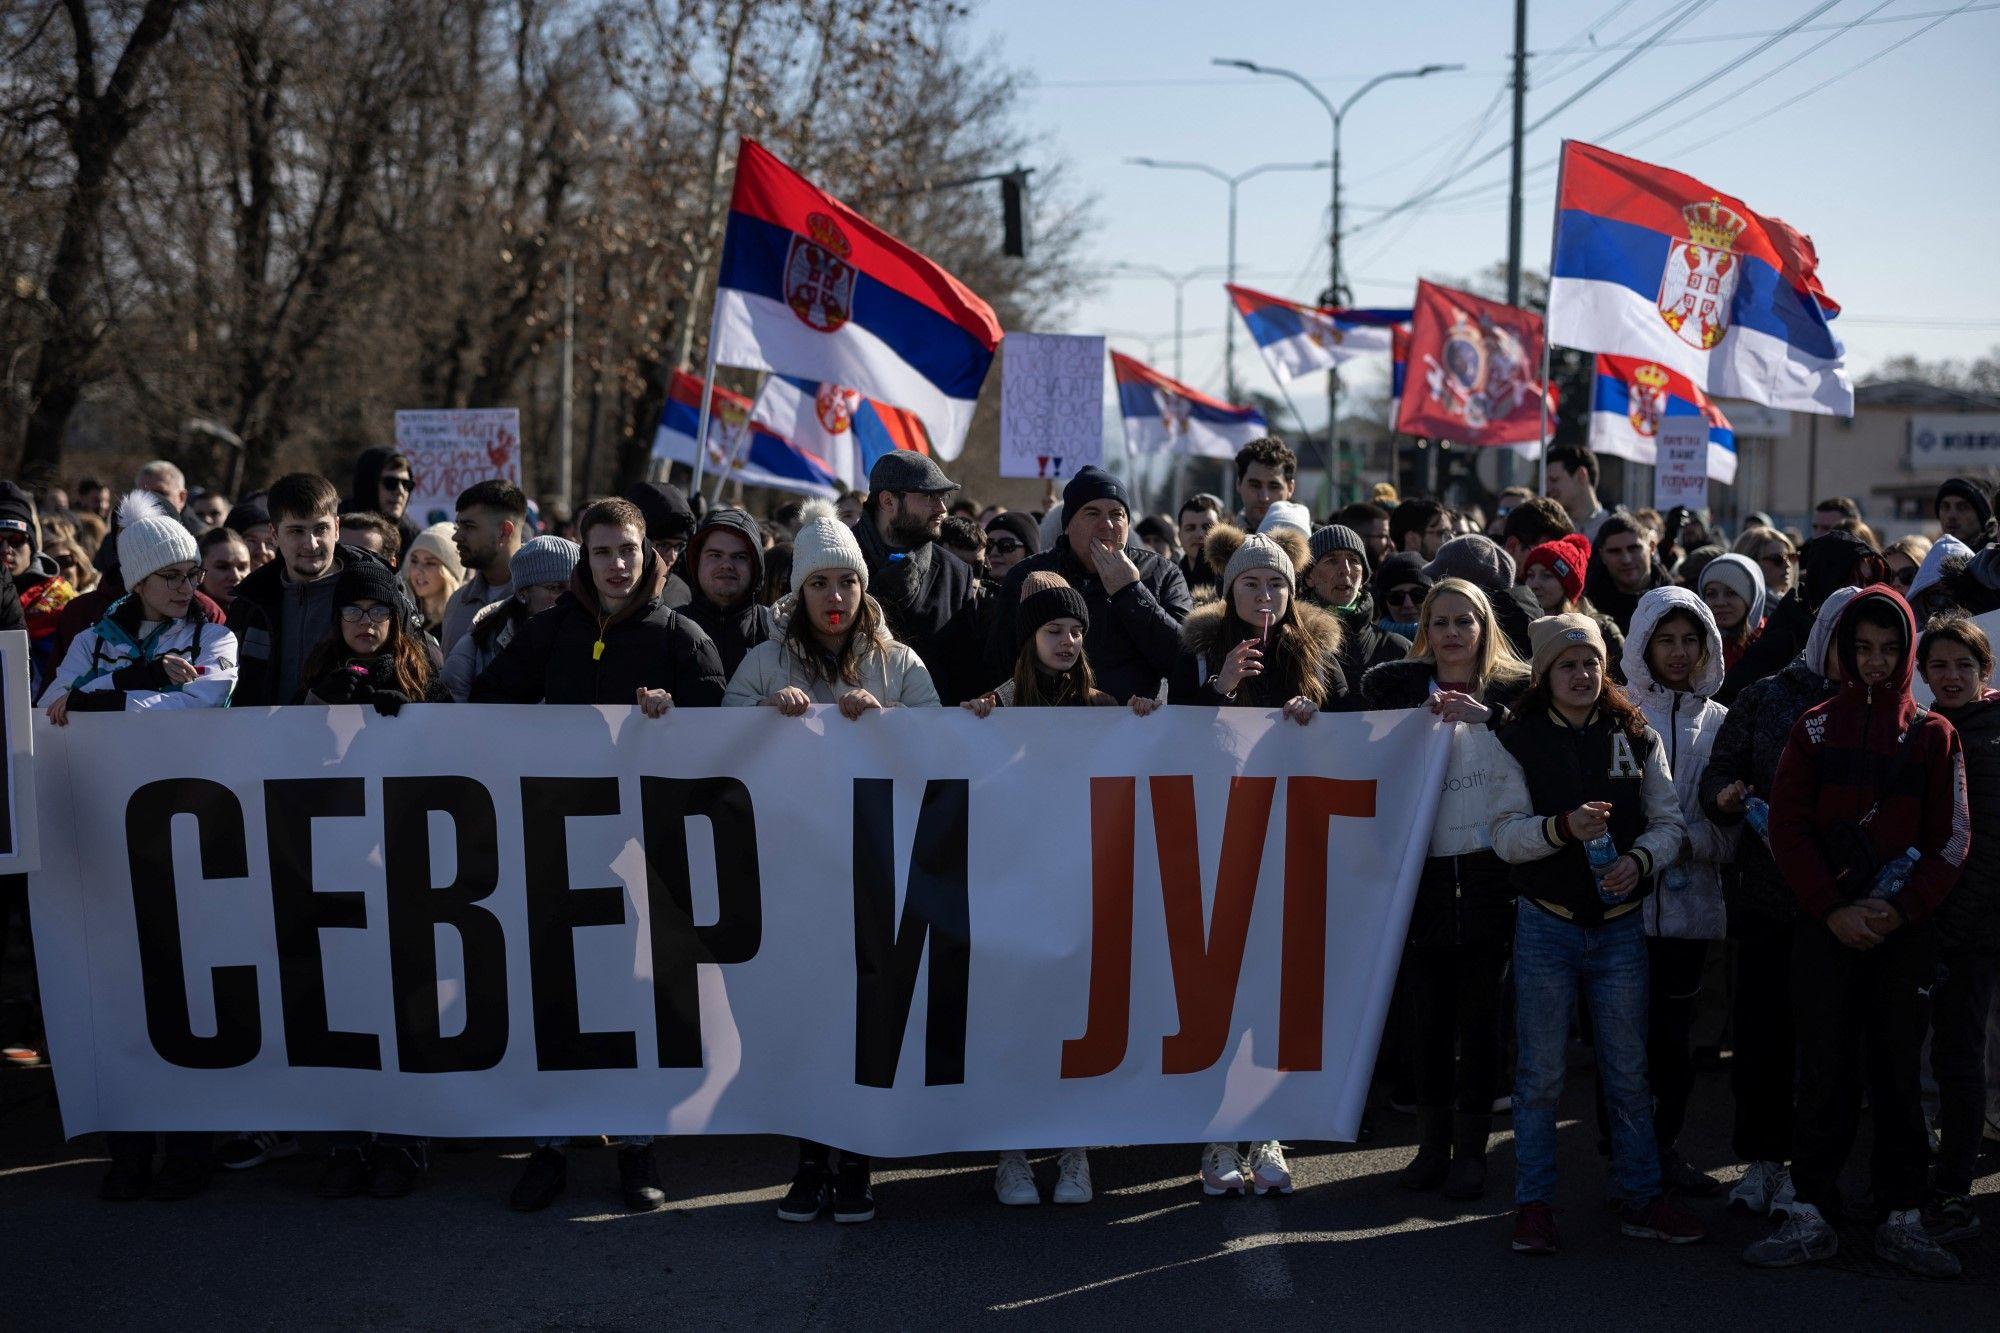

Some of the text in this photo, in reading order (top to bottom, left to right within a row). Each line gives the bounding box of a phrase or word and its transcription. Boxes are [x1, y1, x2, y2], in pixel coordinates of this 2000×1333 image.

[1805, 713, 1828, 728] JUST
[1807, 725, 1825, 736] DO
[1608, 732, 1643, 779] A
[125, 776, 1376, 1089] СЕВЕР И ЈУГ
